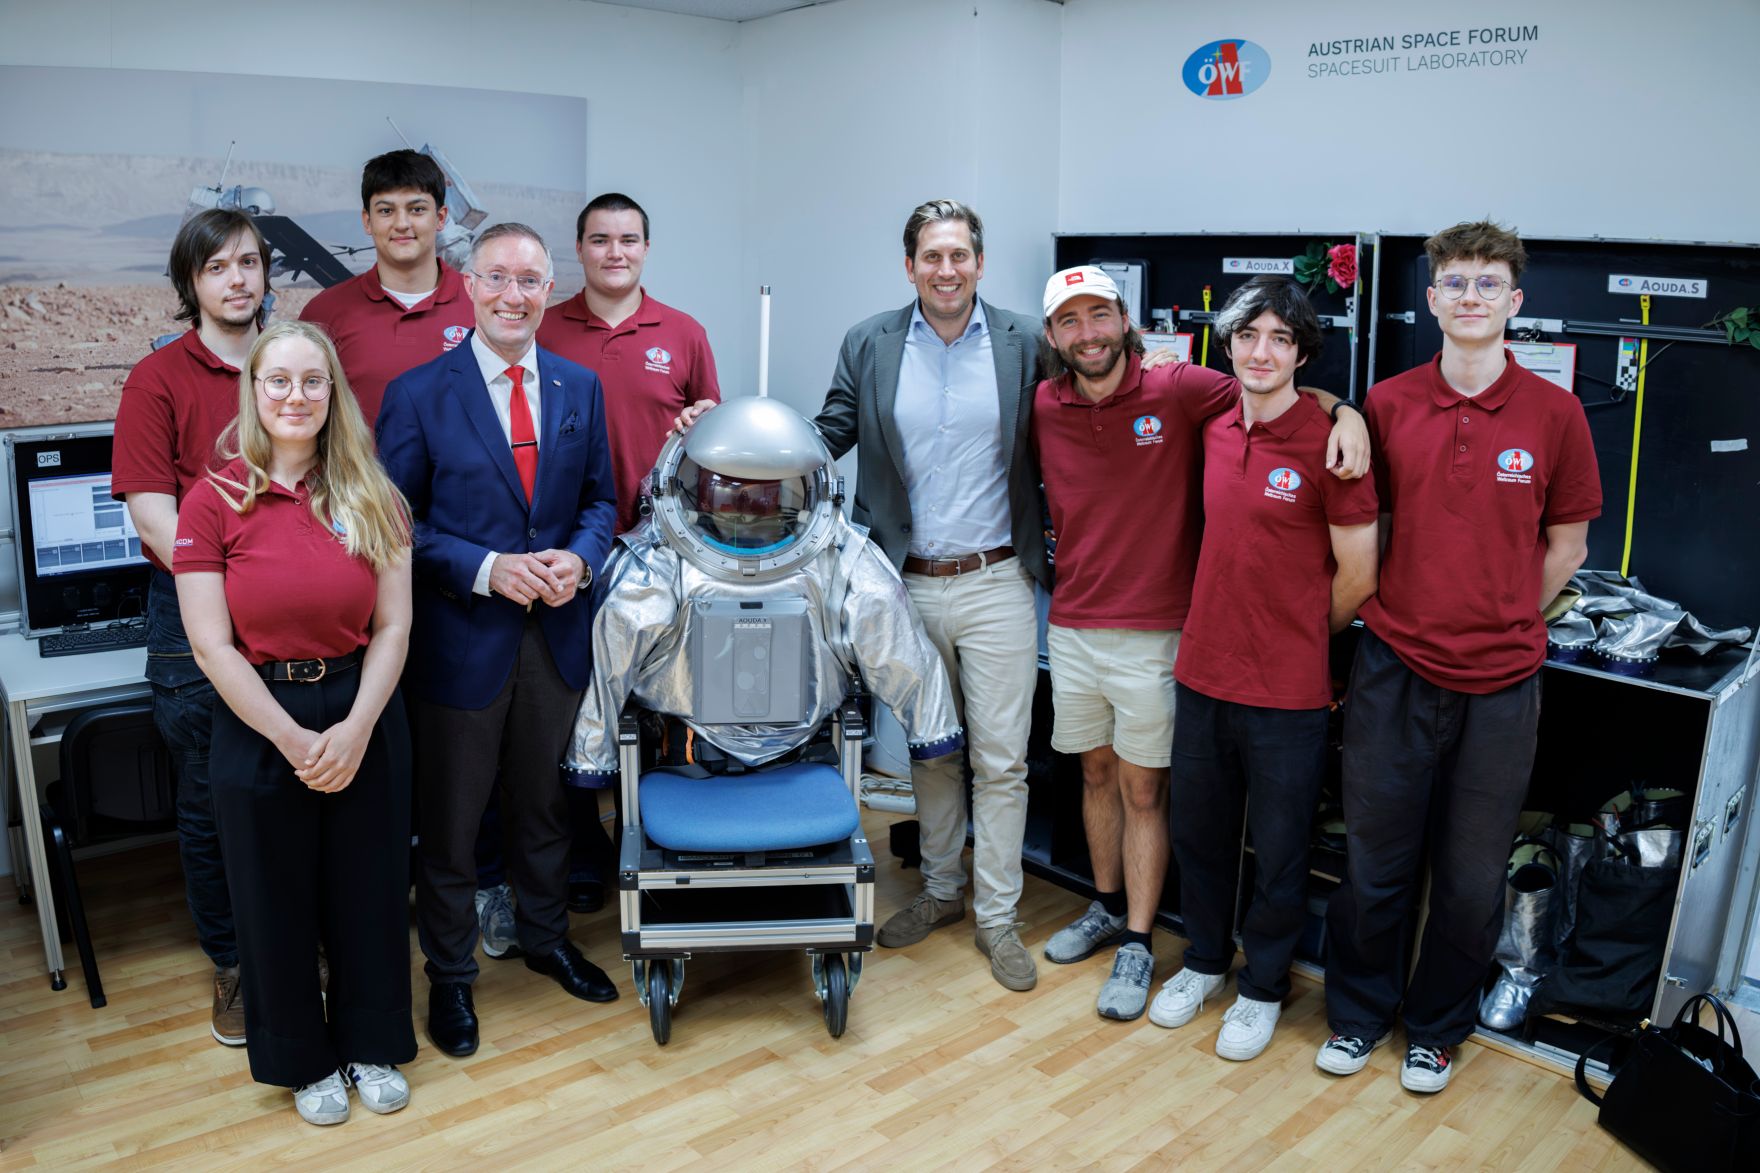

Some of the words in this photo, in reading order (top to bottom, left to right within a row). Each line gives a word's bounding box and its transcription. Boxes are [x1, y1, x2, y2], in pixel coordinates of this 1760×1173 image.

[1308, 36, 1395, 57] AUSTRIAN
[1401, 31, 1461, 49] SPACE
[1468, 25, 1539, 45] FORUM
[1198, 58, 1252, 86] ÖWF
[1308, 57, 1401, 78] SPACESUIT
[1407, 49, 1528, 71] LABORATORY
[38, 453, 60, 464] OPS
